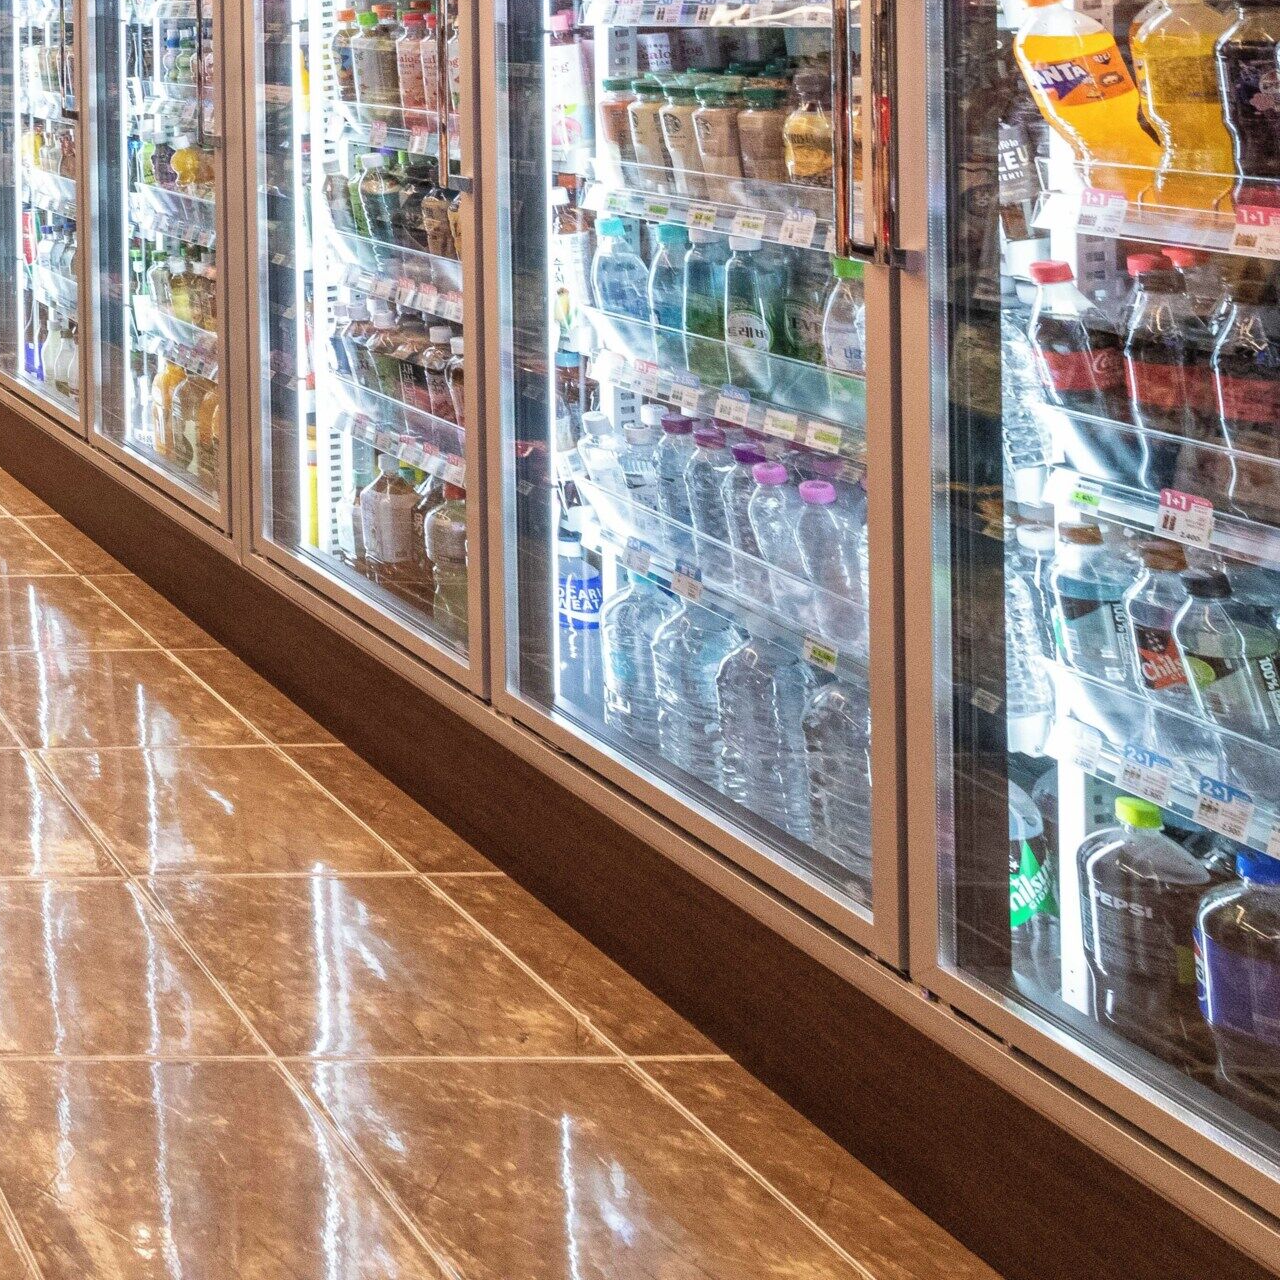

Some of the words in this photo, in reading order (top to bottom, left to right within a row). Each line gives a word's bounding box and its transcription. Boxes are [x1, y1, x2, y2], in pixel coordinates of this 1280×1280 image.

[1033, 61, 1088, 90] ANTA
[1239, 209, 1266, 224] 1+1
[1163, 491, 1188, 511] 1+1
[1126, 745, 1152, 768] 2+1
[1202, 780, 1229, 800] 2+1
